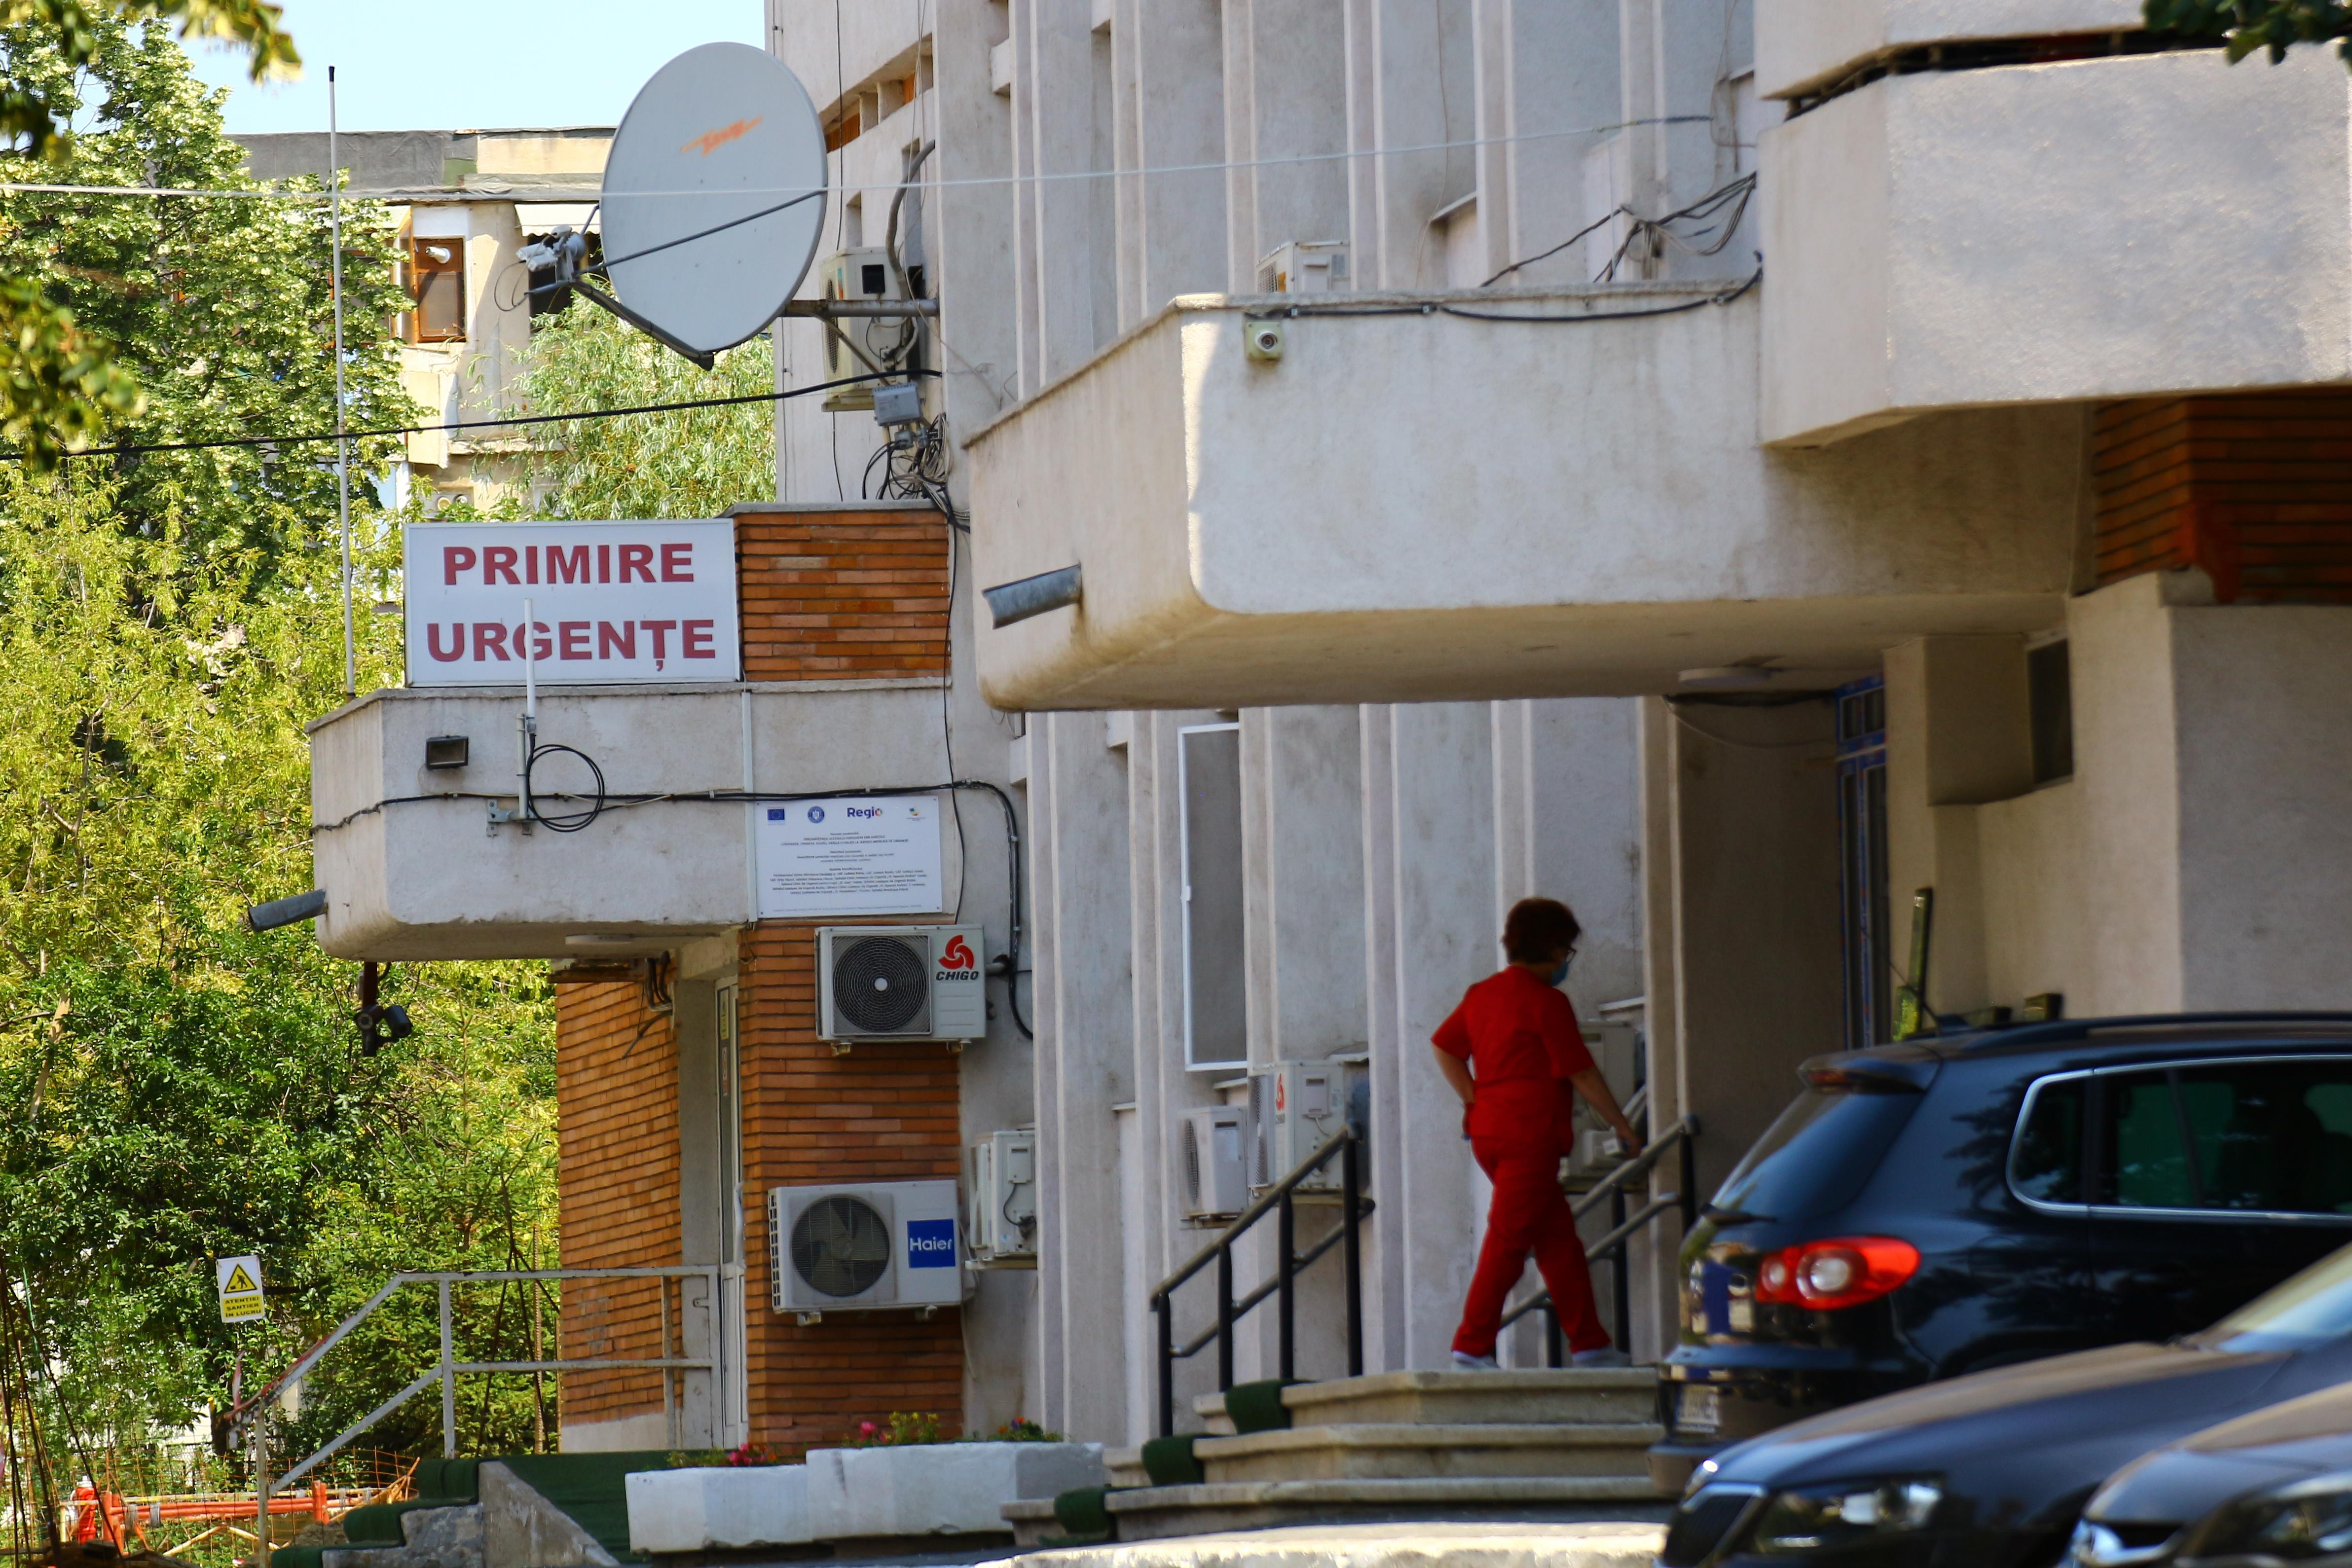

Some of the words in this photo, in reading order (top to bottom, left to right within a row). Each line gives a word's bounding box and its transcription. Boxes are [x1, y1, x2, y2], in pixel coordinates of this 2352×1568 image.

[443, 543, 694, 585] PRIMIRE
[847, 806, 882, 819] Regio
[935, 971, 979, 981] CHIGO
[909, 1237, 953, 1252] Haier
